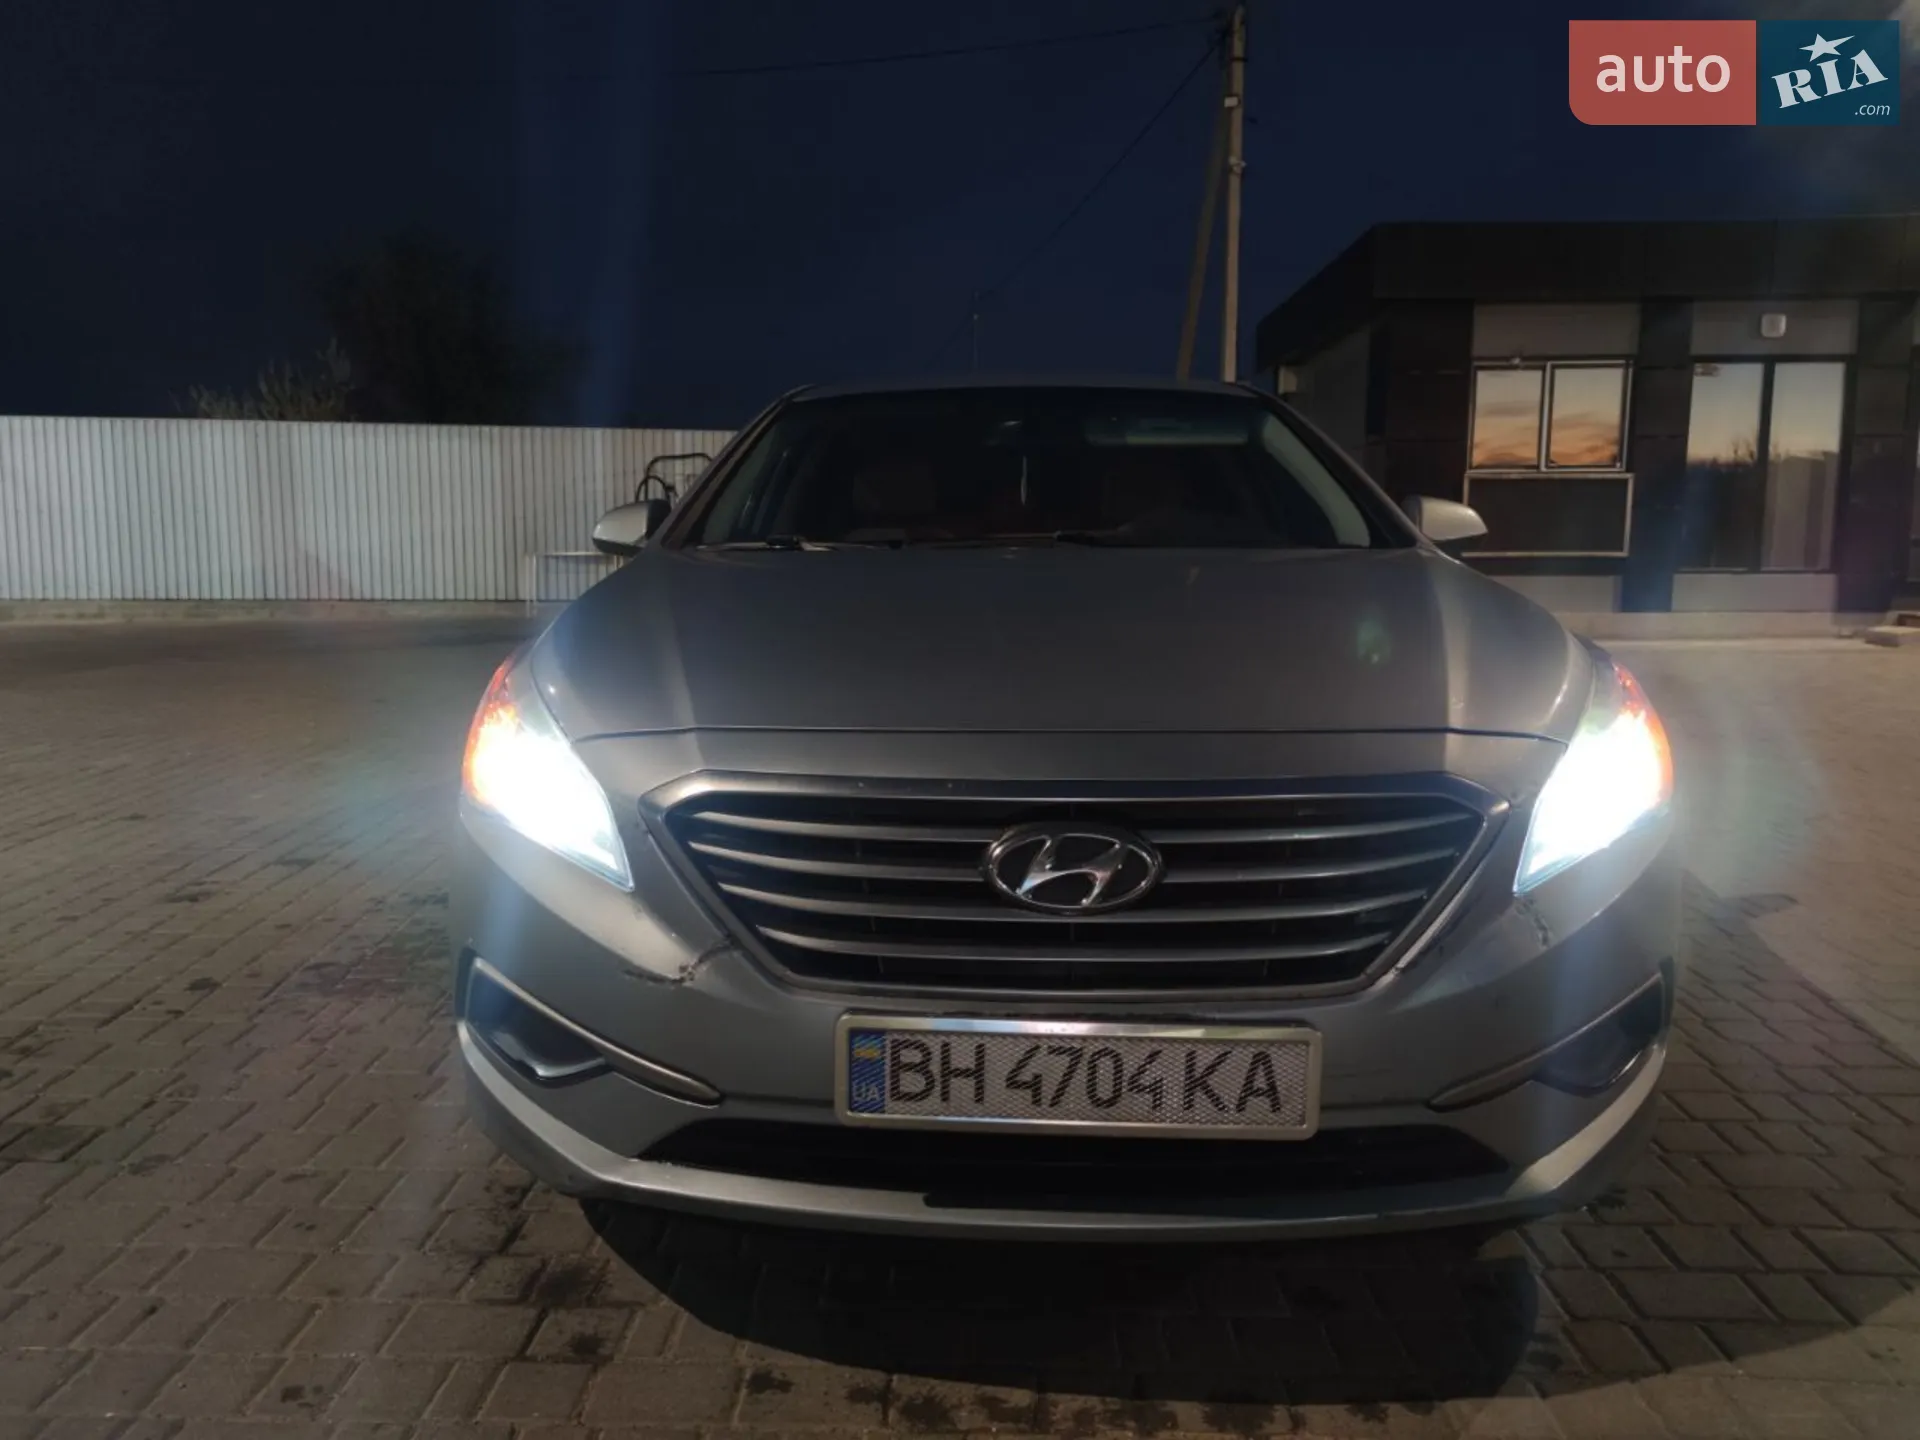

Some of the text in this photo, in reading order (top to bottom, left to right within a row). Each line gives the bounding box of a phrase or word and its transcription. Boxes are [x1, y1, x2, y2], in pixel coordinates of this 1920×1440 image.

[853, 1081, 880, 1102] UA
[890, 1038, 1281, 1113] BH 4704 KA
